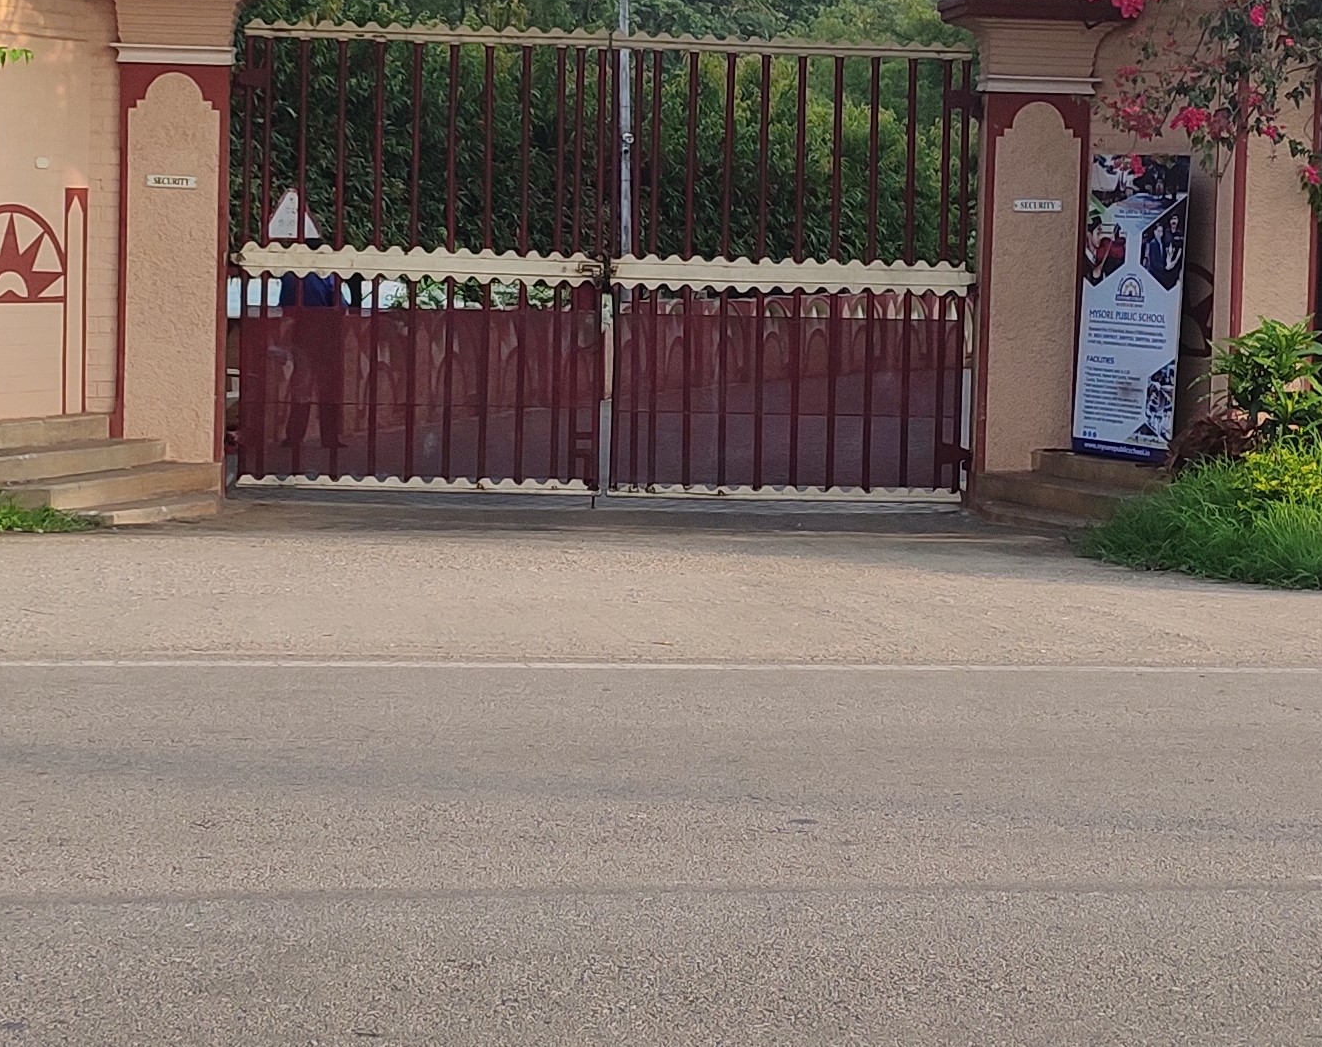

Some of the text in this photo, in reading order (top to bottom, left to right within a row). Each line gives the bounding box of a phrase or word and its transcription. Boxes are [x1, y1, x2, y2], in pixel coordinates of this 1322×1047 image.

[153, 177, 189, 186] SECURITY
[1020, 201, 1056, 209] SECURITY
[1089, 309, 1113, 319] MYSORE
[1115, 311, 1137, 321] PUBLIC
[1138, 313, 1165, 324] SCHOOL
